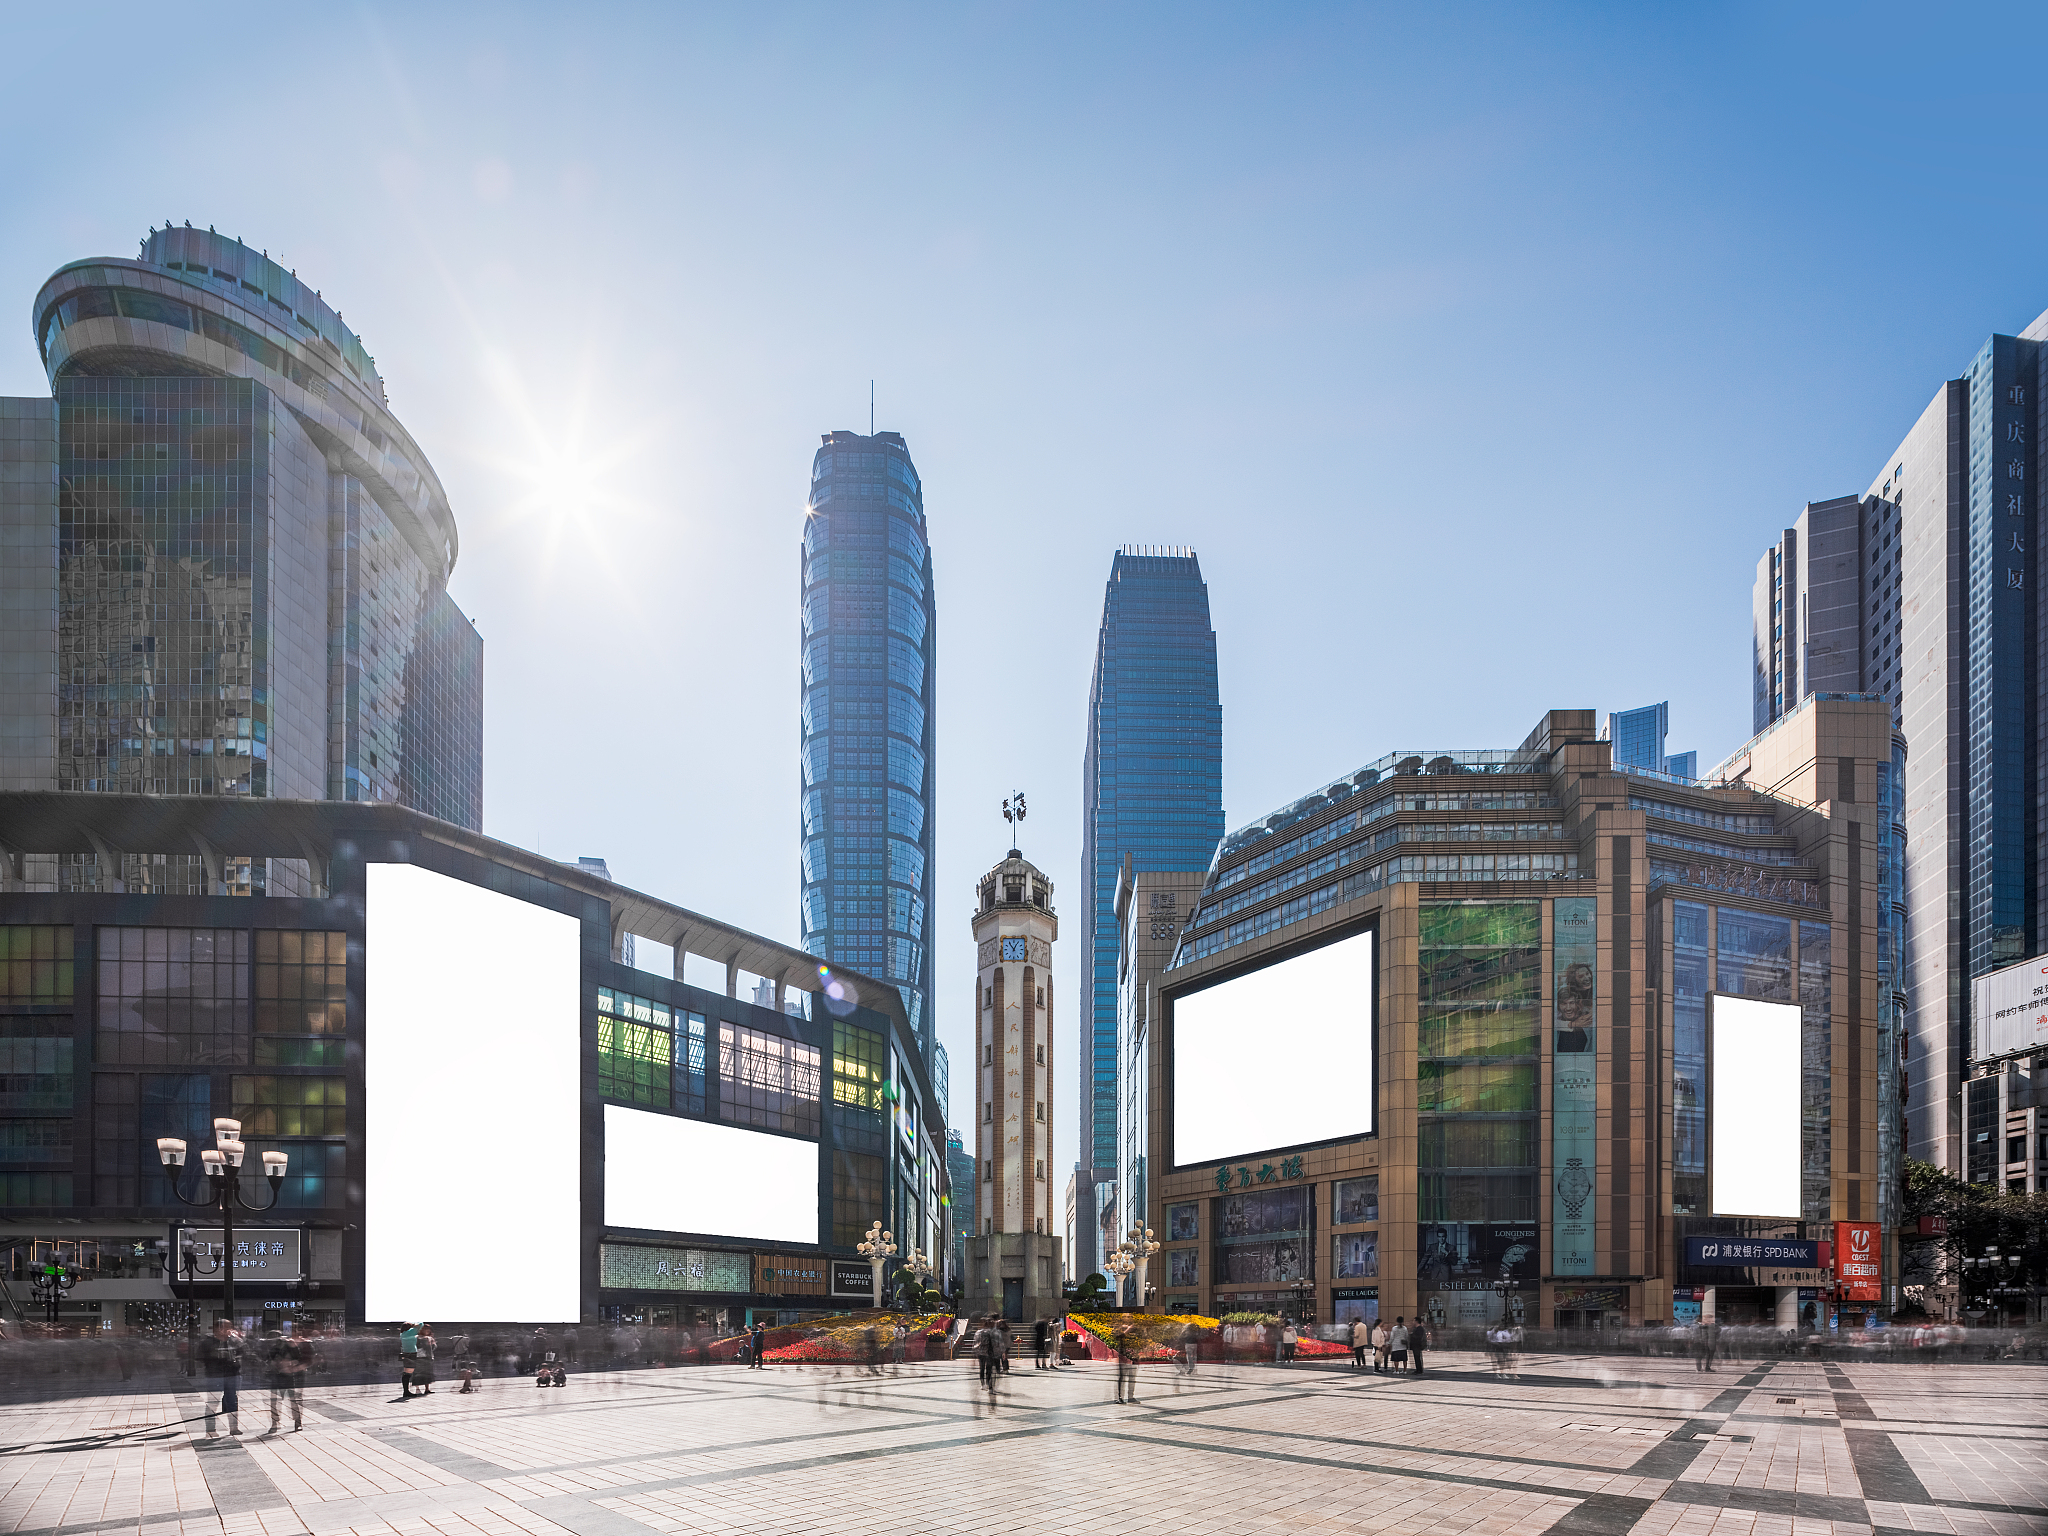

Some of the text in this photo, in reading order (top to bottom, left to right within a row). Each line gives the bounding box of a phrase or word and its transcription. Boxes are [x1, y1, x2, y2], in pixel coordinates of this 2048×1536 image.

[2006, 384, 2025, 590] 重庆商社大厦
[1214, 1155, 1305, 1193] 重百大楼
[1722, 1244, 1808, 1259] 浦发银行 SPD BANK
[1851, 1253, 1869, 1261] CBEST
[656, 1261, 705, 1278] 周六福
[777, 1268, 823, 1279] 中国农业银行
[1843, 1263, 1878, 1276] 重百超市
